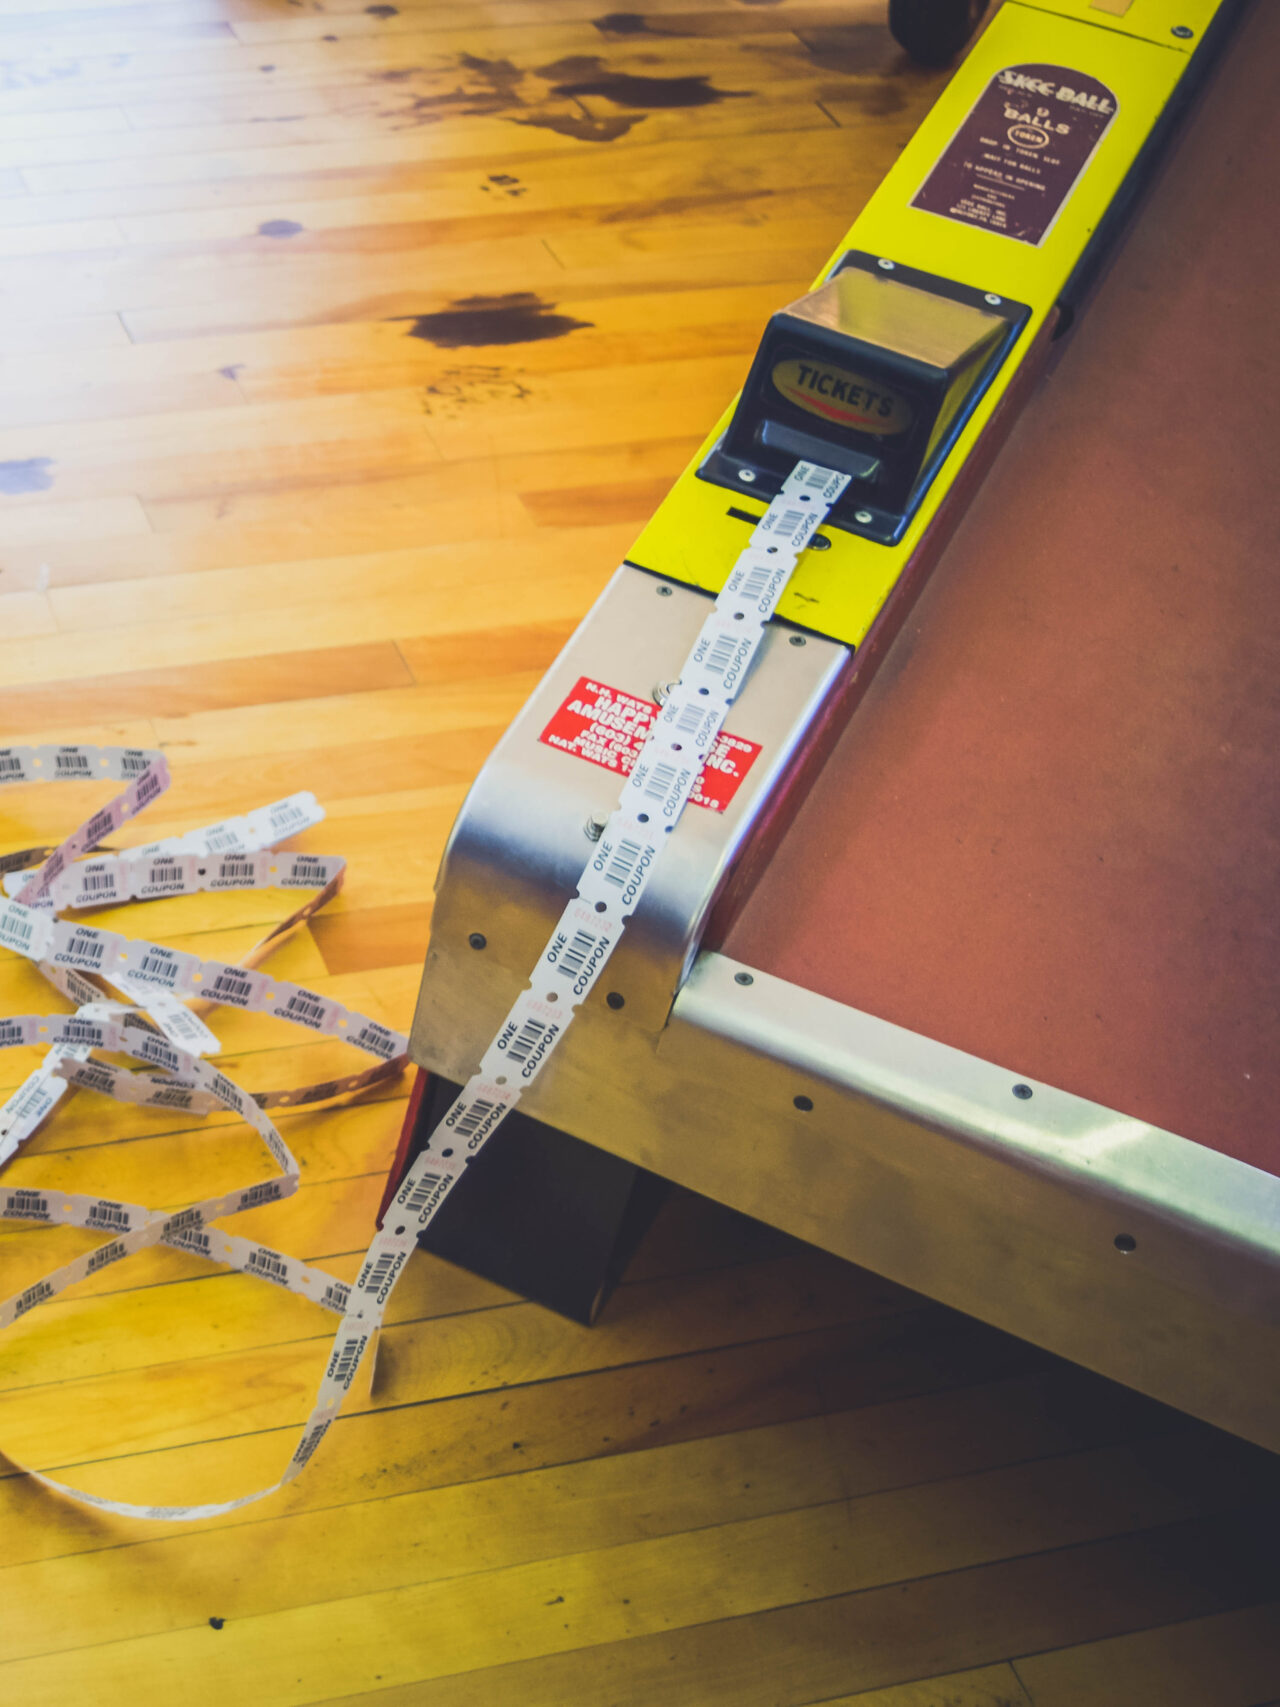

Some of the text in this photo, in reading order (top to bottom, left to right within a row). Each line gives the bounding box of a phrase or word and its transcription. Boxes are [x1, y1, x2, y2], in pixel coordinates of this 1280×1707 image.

[1004, 107, 1070, 135] BALLS
[796, 362, 896, 417] TICKETS
[762, 512, 778, 530] ONE
[792, 512, 818, 547] COUPON
[728, 570, 744, 591] ONE
[758, 568, 786, 613] COUPON
[694, 638, 710, 663] ONE
[723, 637, 752, 690] COUPON
[616, 694, 653, 715] WATS
[663, 703, 680, 723] ONE
[580, 729, 608, 747] FAX
[695, 709, 720, 747] COUPON
[548, 734, 577, 753] NAT.
[581, 747, 618, 768] WATS
[632, 763, 649, 788] ONE
[663, 768, 691, 817] COUPON
[206, 825, 225, 836] ONE
[142, 845, 160, 855] ONE
[224, 854, 247, 862] ONE
[296, 855, 319, 864] ONE
[593, 840, 613, 871] ONE
[85, 864, 106, 873] ONE
[153, 857, 174, 866] ONE
[210, 878, 255, 888] COUPON
[281, 878, 328, 887] COUPON
[622, 845, 656, 906] COUPON
[76, 891, 117, 903] COUPON
[141, 881, 185, 894] COUPON
[8, 905, 29, 918] ONE
[75, 927, 99, 939] ONE
[150, 947, 174, 958] ONE
[547, 932, 568, 963] ONE
[54, 953, 101, 969] COUPON
[573, 936, 610, 995] COUPON
[127, 969, 175, 988] COUPON
[224, 967, 248, 978] ONE
[201, 988, 248, 1006] COUPON
[298, 990, 321, 1002] ONE
[68, 1018, 94, 1026] ONE
[274, 1007, 321, 1029] COUPON
[369, 1022, 392, 1036] ONE
[497, 1021, 518, 1050] ONE
[52, 1036, 104, 1048] COUPON
[147, 1036, 169, 1047] ONE
[346, 1035, 392, 1060] COUPON
[521, 1024, 560, 1078] COUPON
[131, 1049, 179, 1072] COUPON
[150, 1077, 195, 1089] COUPON
[445, 1102, 467, 1127] ONE
[468, 1102, 507, 1149] COUPON
[15, 1189, 40, 1198] ONE
[397, 1178, 416, 1204] ONE
[418, 1173, 454, 1224] COUPON
[3, 1209, 51, 1220] COUPON
[98, 1200, 123, 1209] ONE
[85, 1218, 132, 1233] COUPON
[257, 1247, 282, 1259] ONE
[243, 1263, 289, 1286] COUPON
[357, 1262, 374, 1289] ONE
[376, 1251, 407, 1305] COUPON
[327, 1350, 341, 1378] ONE
[343, 1335, 368, 1391] COUPON
